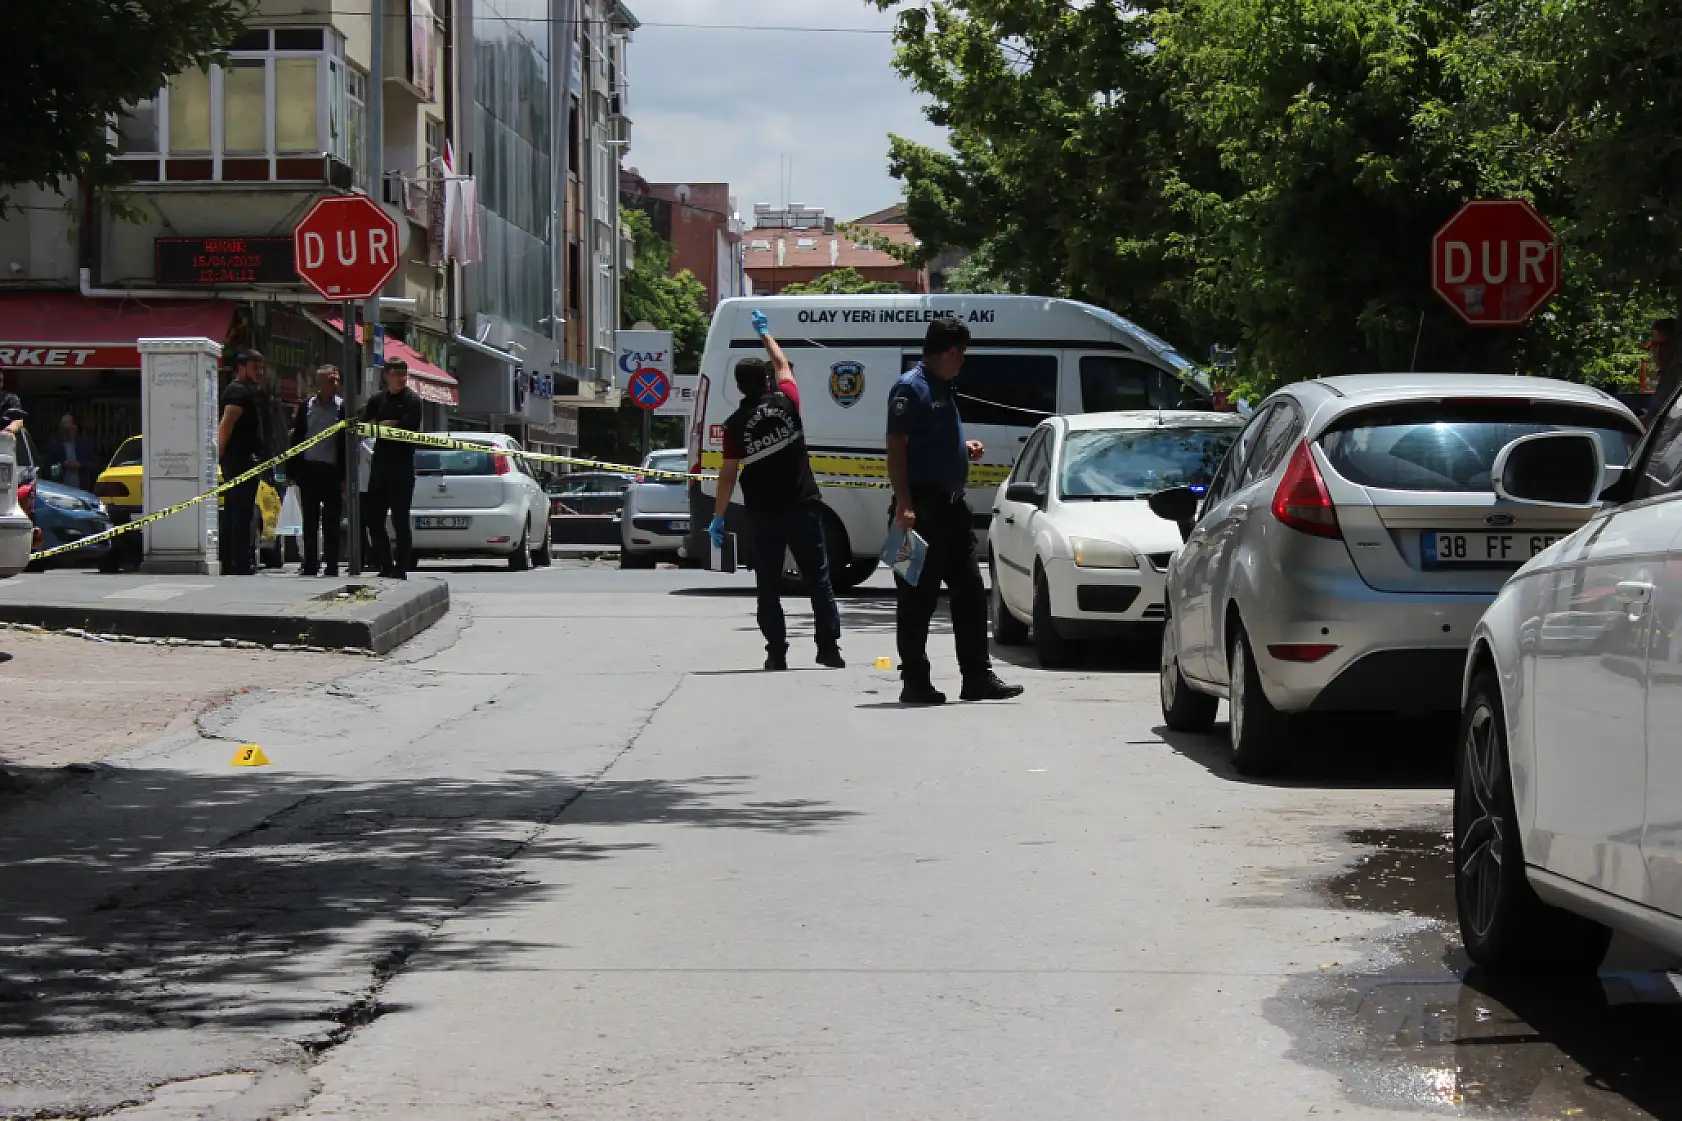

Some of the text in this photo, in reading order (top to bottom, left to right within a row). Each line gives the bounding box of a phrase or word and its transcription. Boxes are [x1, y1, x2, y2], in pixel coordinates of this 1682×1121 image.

[304, 228, 389, 268] DUR
[1445, 240, 1545, 284] DUR
[798, 309, 838, 323] OLAY
[842, 309, 876, 323] YERİ
[1439, 535, 1467, 558] 38
[1485, 535, 1513, 559] FF
[242, 749, 254, 761] 3
